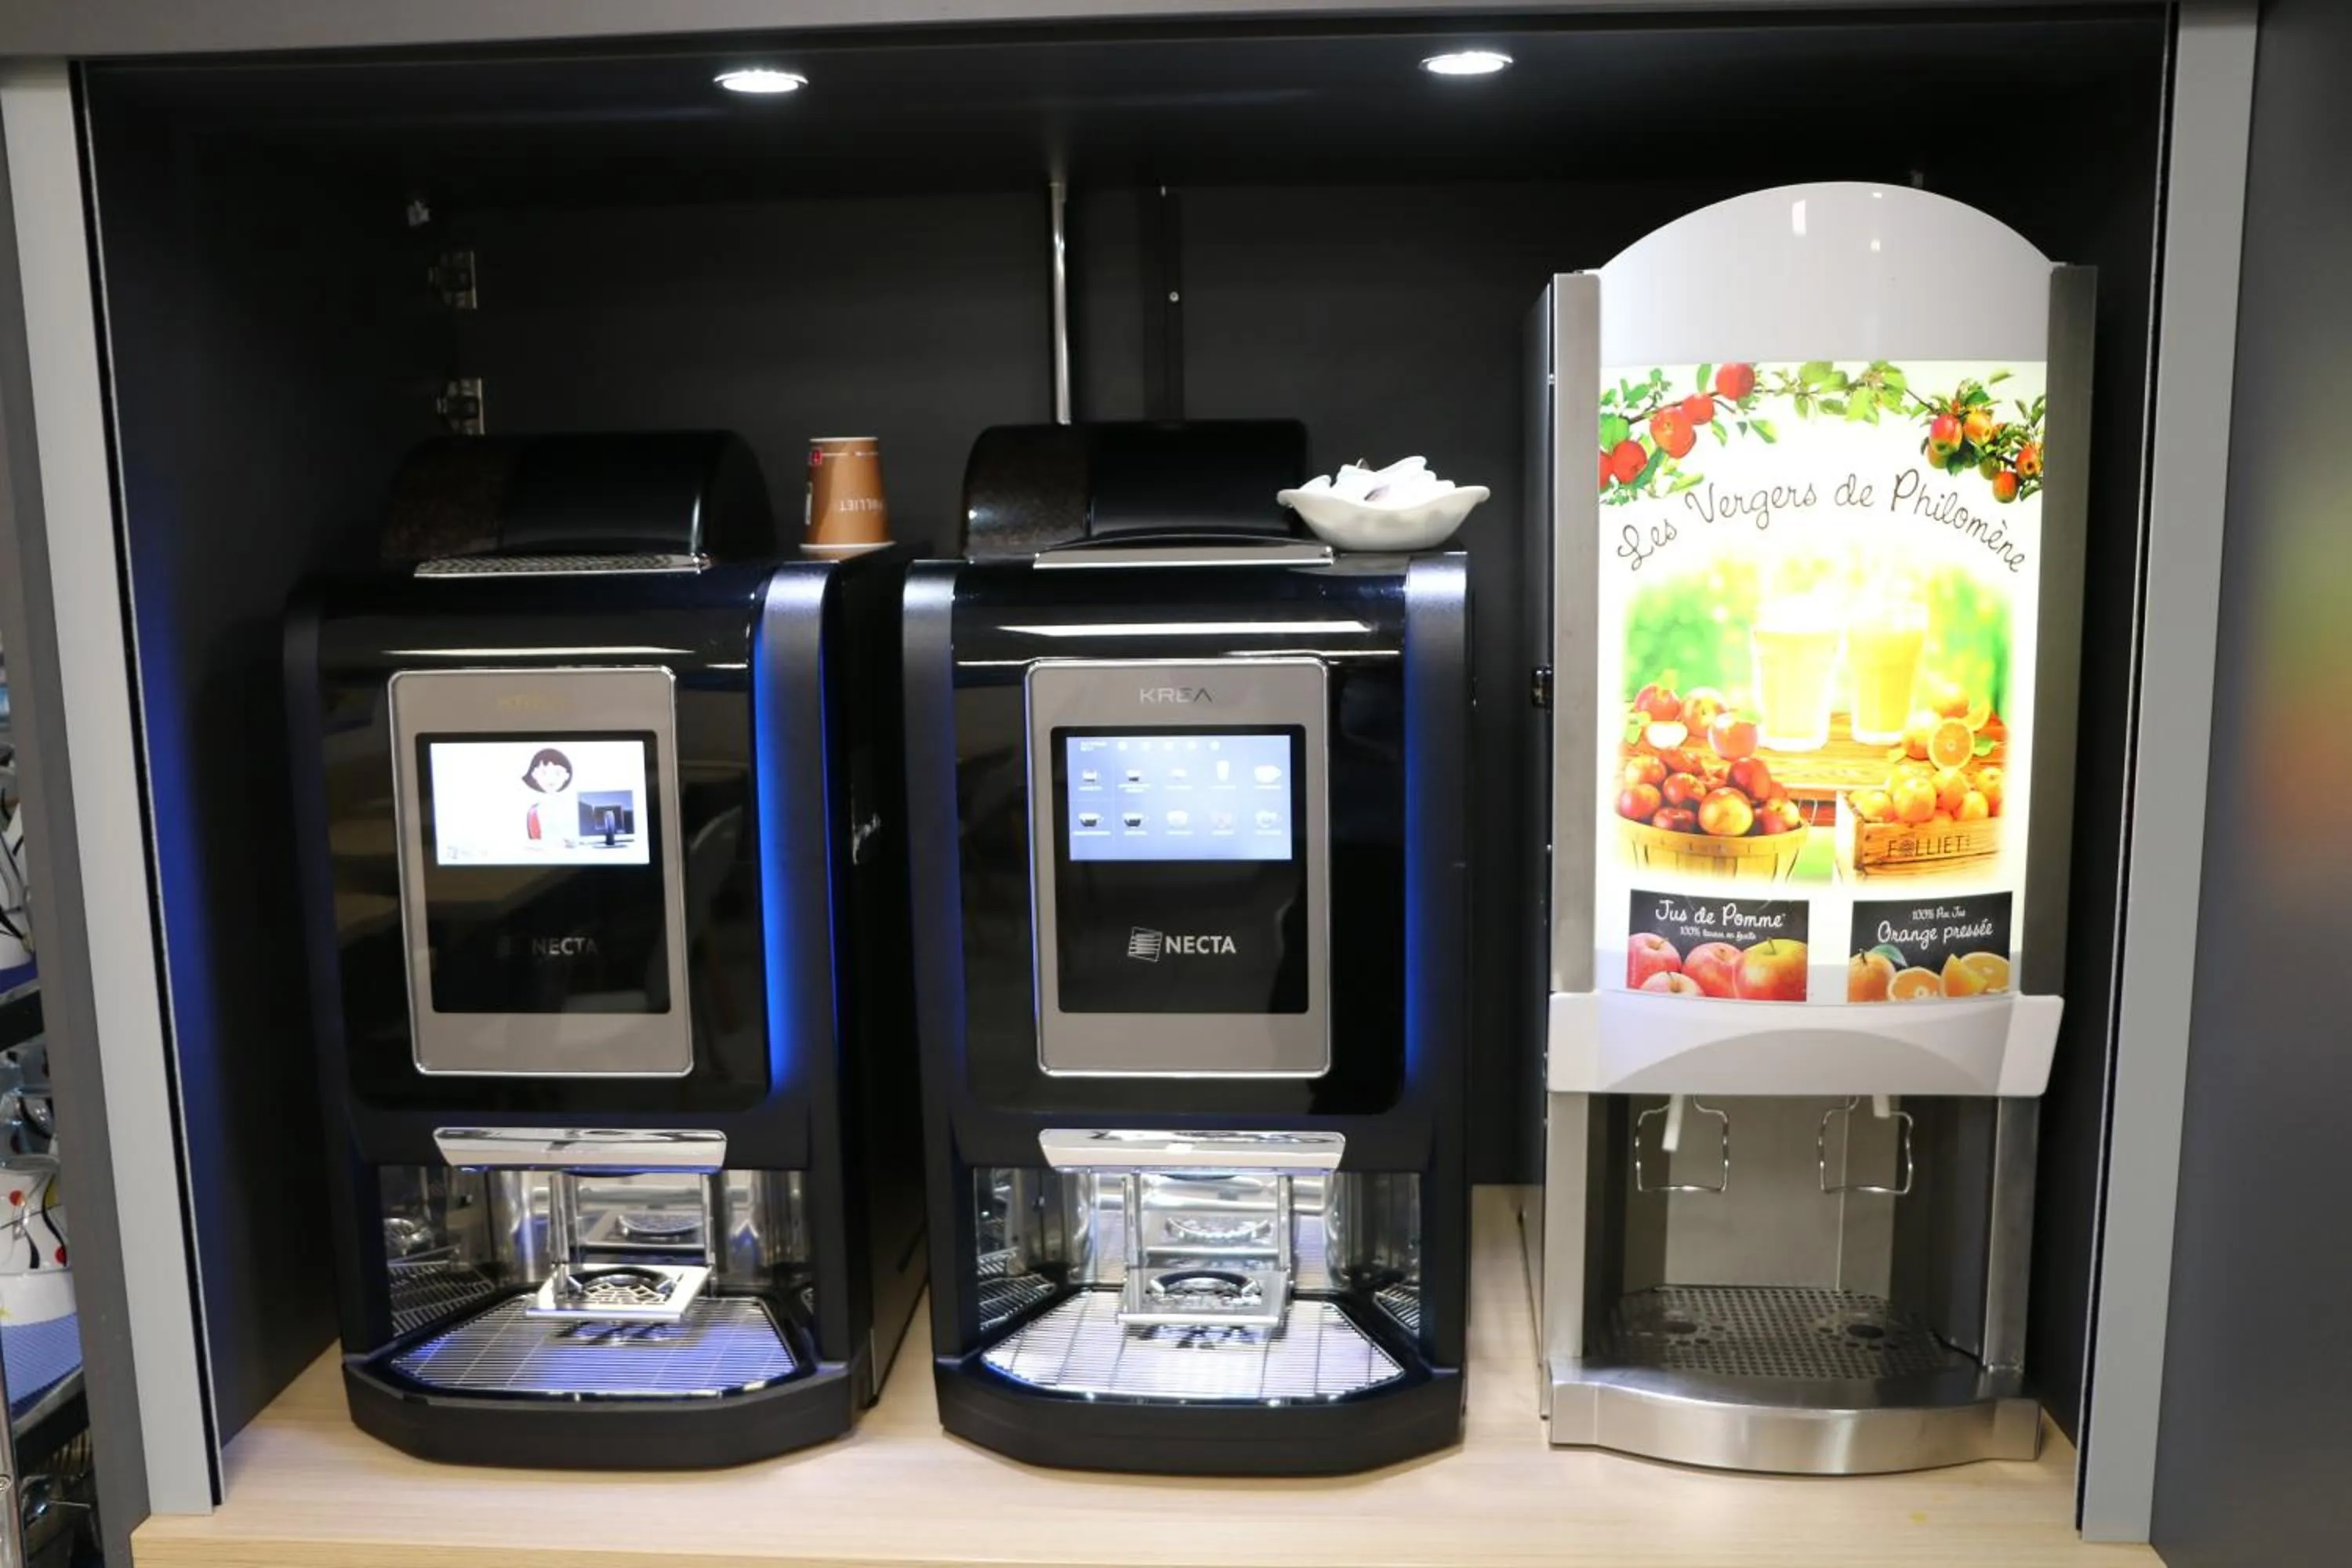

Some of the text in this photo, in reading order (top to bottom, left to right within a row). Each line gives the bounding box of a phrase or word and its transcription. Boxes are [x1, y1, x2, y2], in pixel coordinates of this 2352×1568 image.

[1617, 468, 2026, 573] Les Vergers de Philomène
[1139, 687, 1214, 704] KREA
[1655, 899, 1784, 928] Jus de Pomme
[1164, 935, 1236, 955] NECTA
[1877, 917, 1994, 950] Orange pressée
